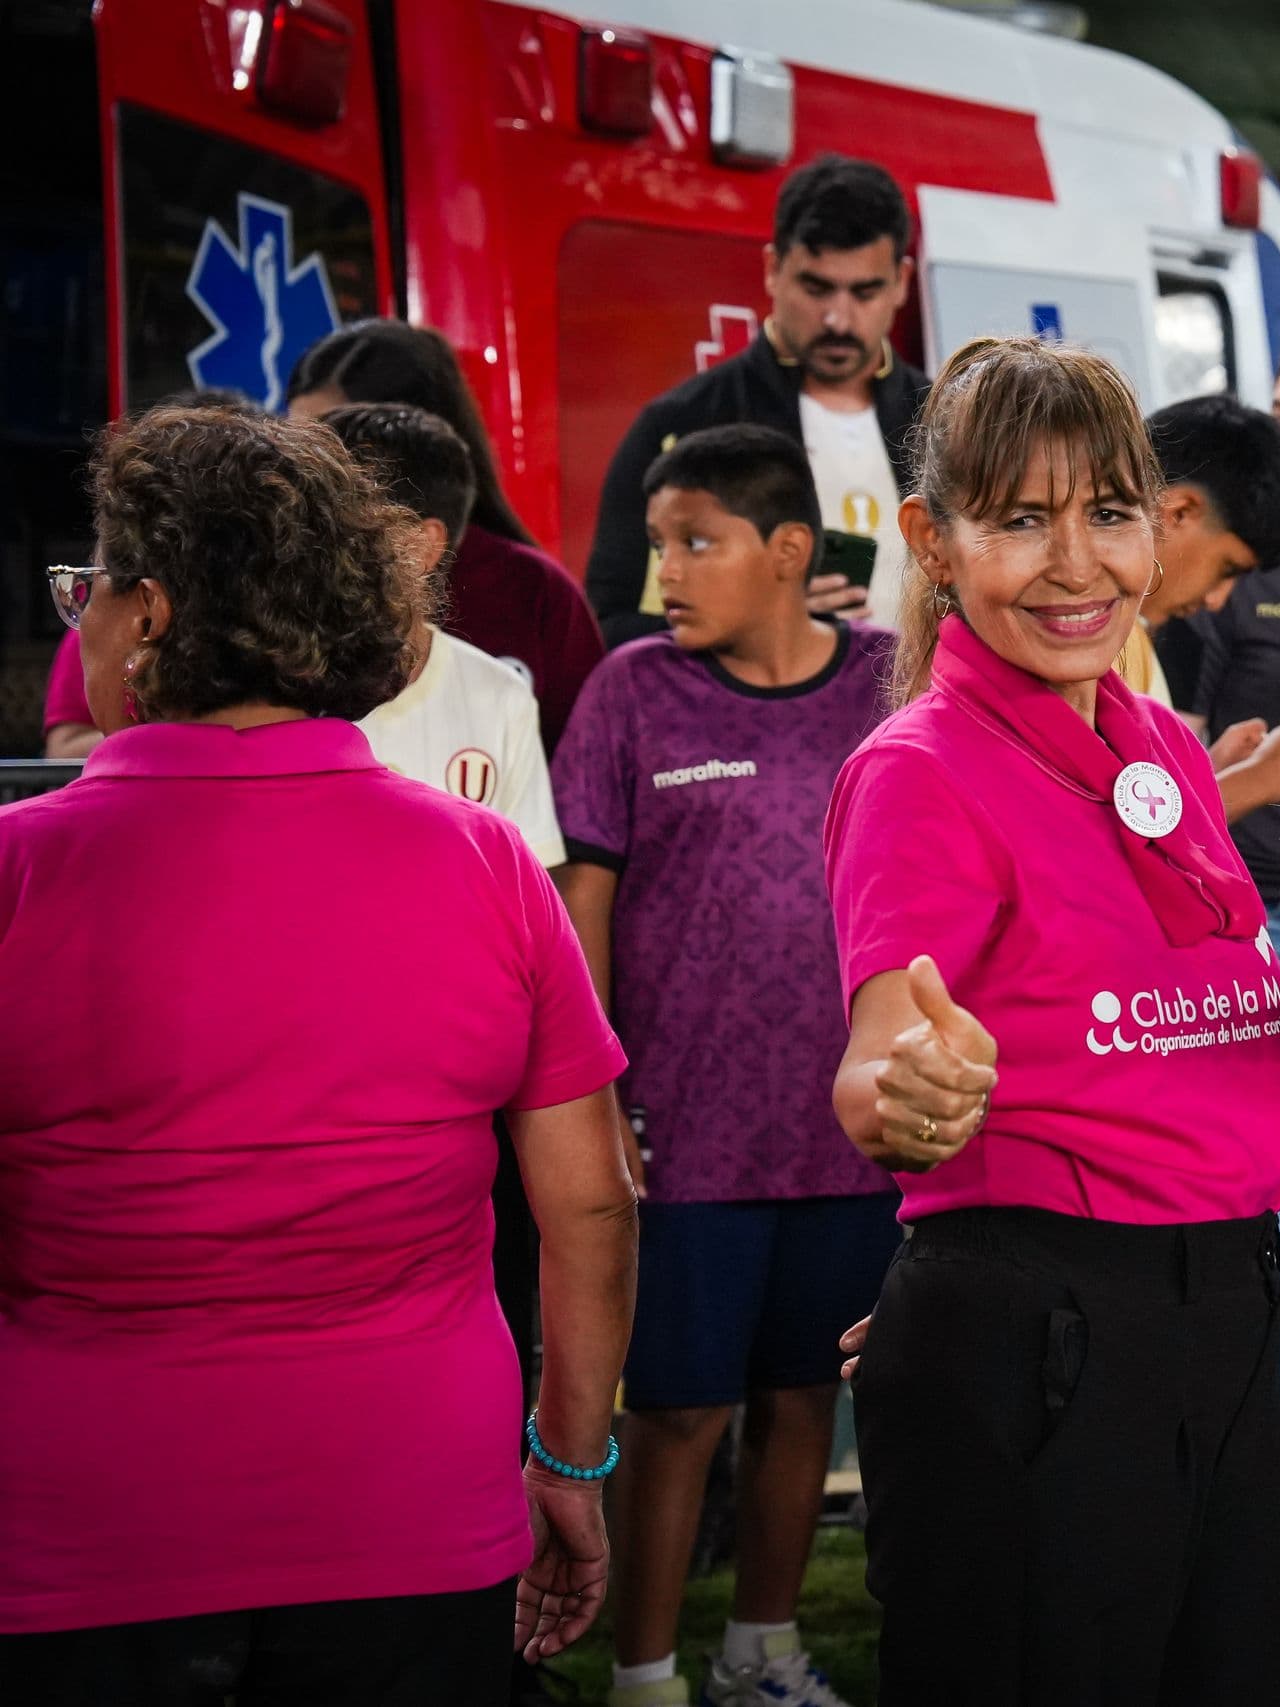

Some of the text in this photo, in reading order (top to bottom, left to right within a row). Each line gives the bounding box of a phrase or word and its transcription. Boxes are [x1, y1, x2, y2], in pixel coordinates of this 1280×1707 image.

[460, 759, 489, 804] U
[653, 758, 757, 790] marathon
[1130, 987, 1197, 1027] Club
[1203, 984, 1231, 1020] de
[1233, 979, 1259, 1015] la
[1141, 1027, 1215, 1056] Organización
[1217, 1024, 1230, 1044] de
[1231, 1019, 1261, 1042] lucha
